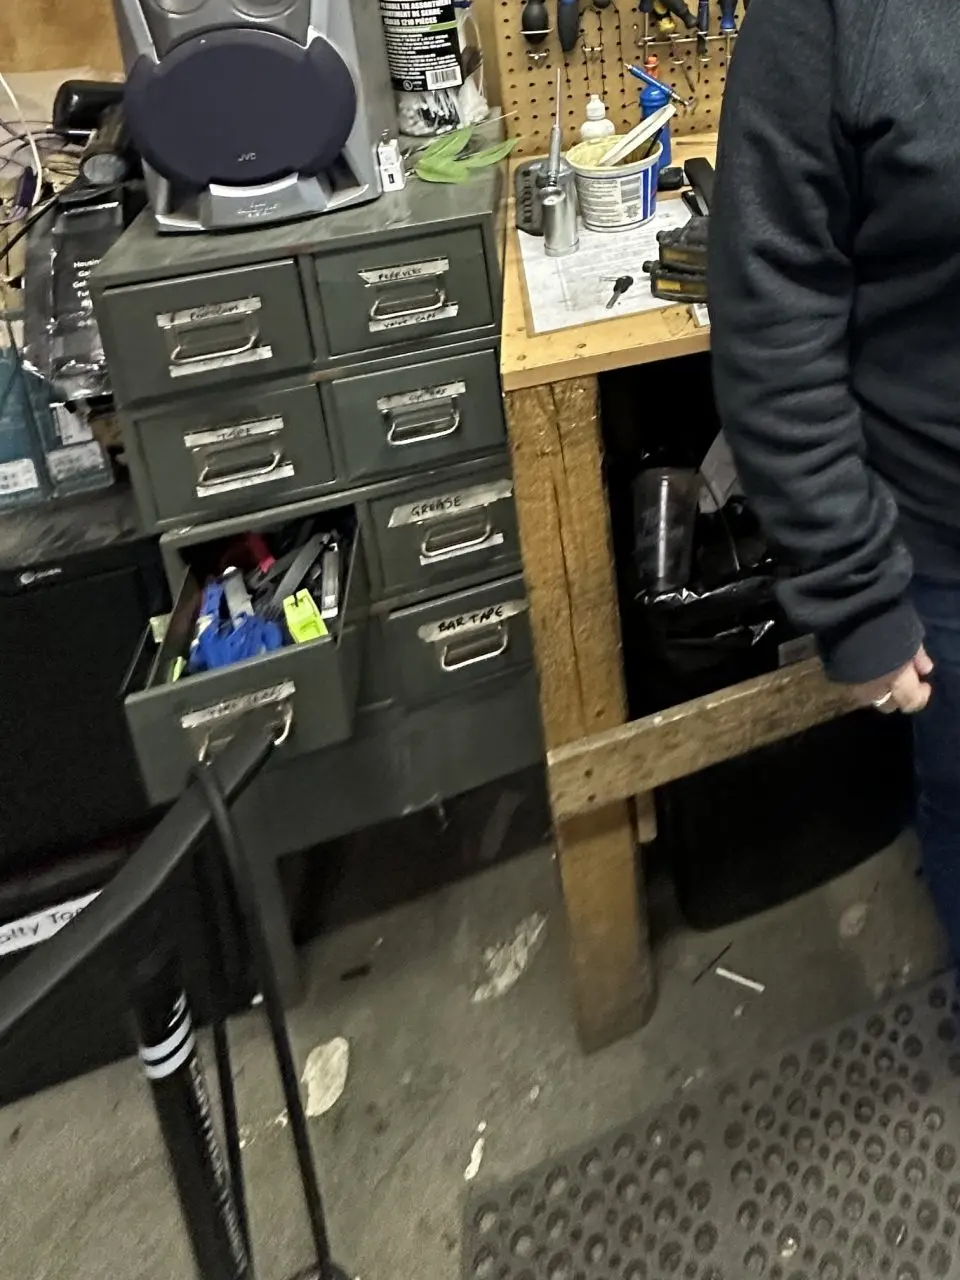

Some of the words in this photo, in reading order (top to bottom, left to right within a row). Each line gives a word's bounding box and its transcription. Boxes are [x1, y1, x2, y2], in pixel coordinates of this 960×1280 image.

[238, 152, 257, 162] JVC
[410, 495, 462, 517] GREASE
[438, 616, 465, 632] BAR
[469, 605, 504, 624] TAPE
